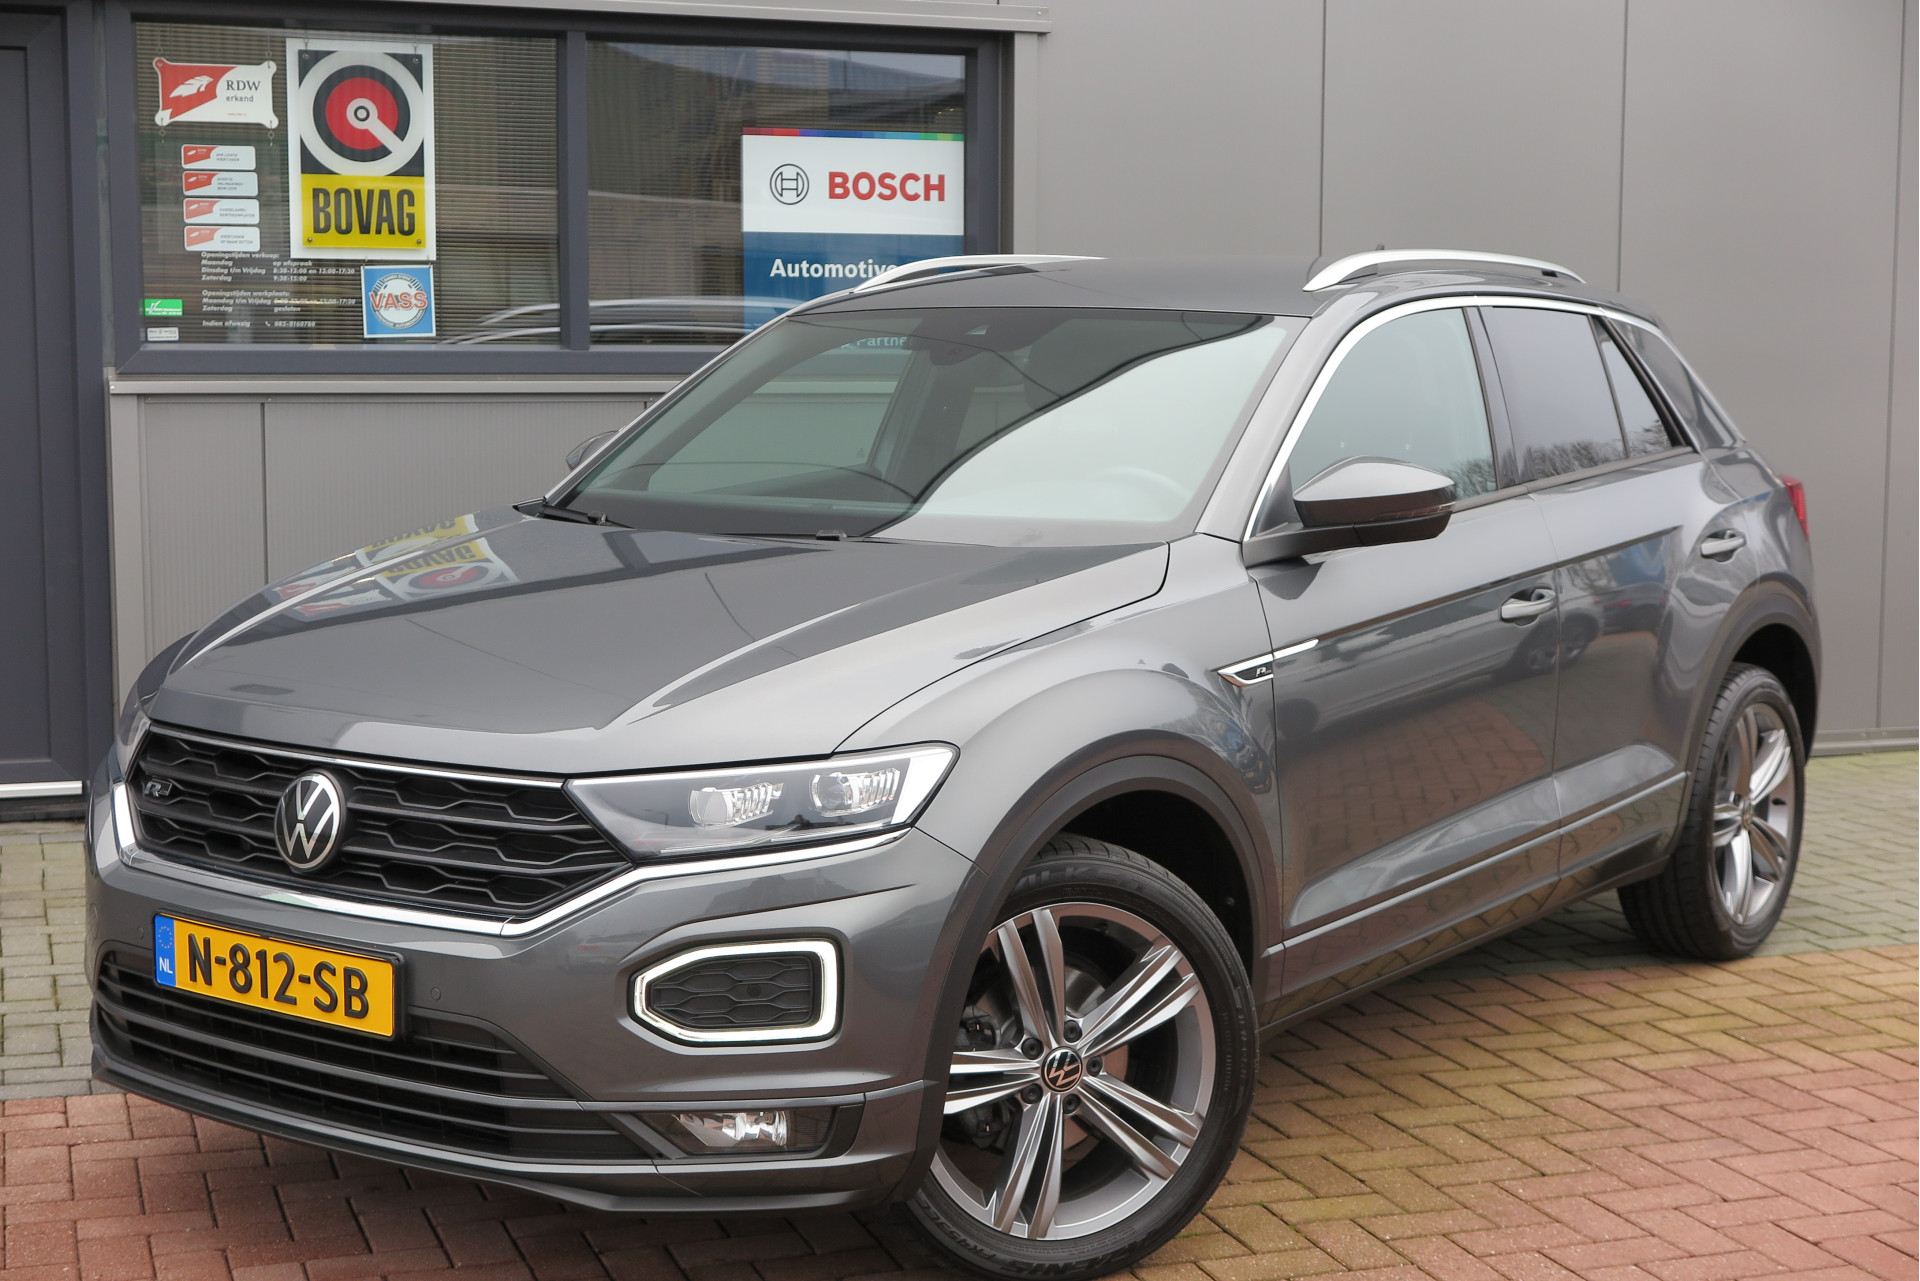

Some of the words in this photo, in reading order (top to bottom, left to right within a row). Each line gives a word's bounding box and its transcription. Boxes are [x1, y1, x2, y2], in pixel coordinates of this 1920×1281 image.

[226, 80, 261, 91] RDW
[828, 171, 946, 202] BOSCH
[312, 187, 416, 237] BOVAG
[201, 259, 233, 267] Maandag
[242, 267, 266, 275] Vrijdag
[202, 297, 234, 305] Maandag
[368, 291, 428, 310] VASS
[856, 336, 911, 347] artne
[159, 957, 174, 975] NL
[187, 932, 370, 1020] N-812-SB
